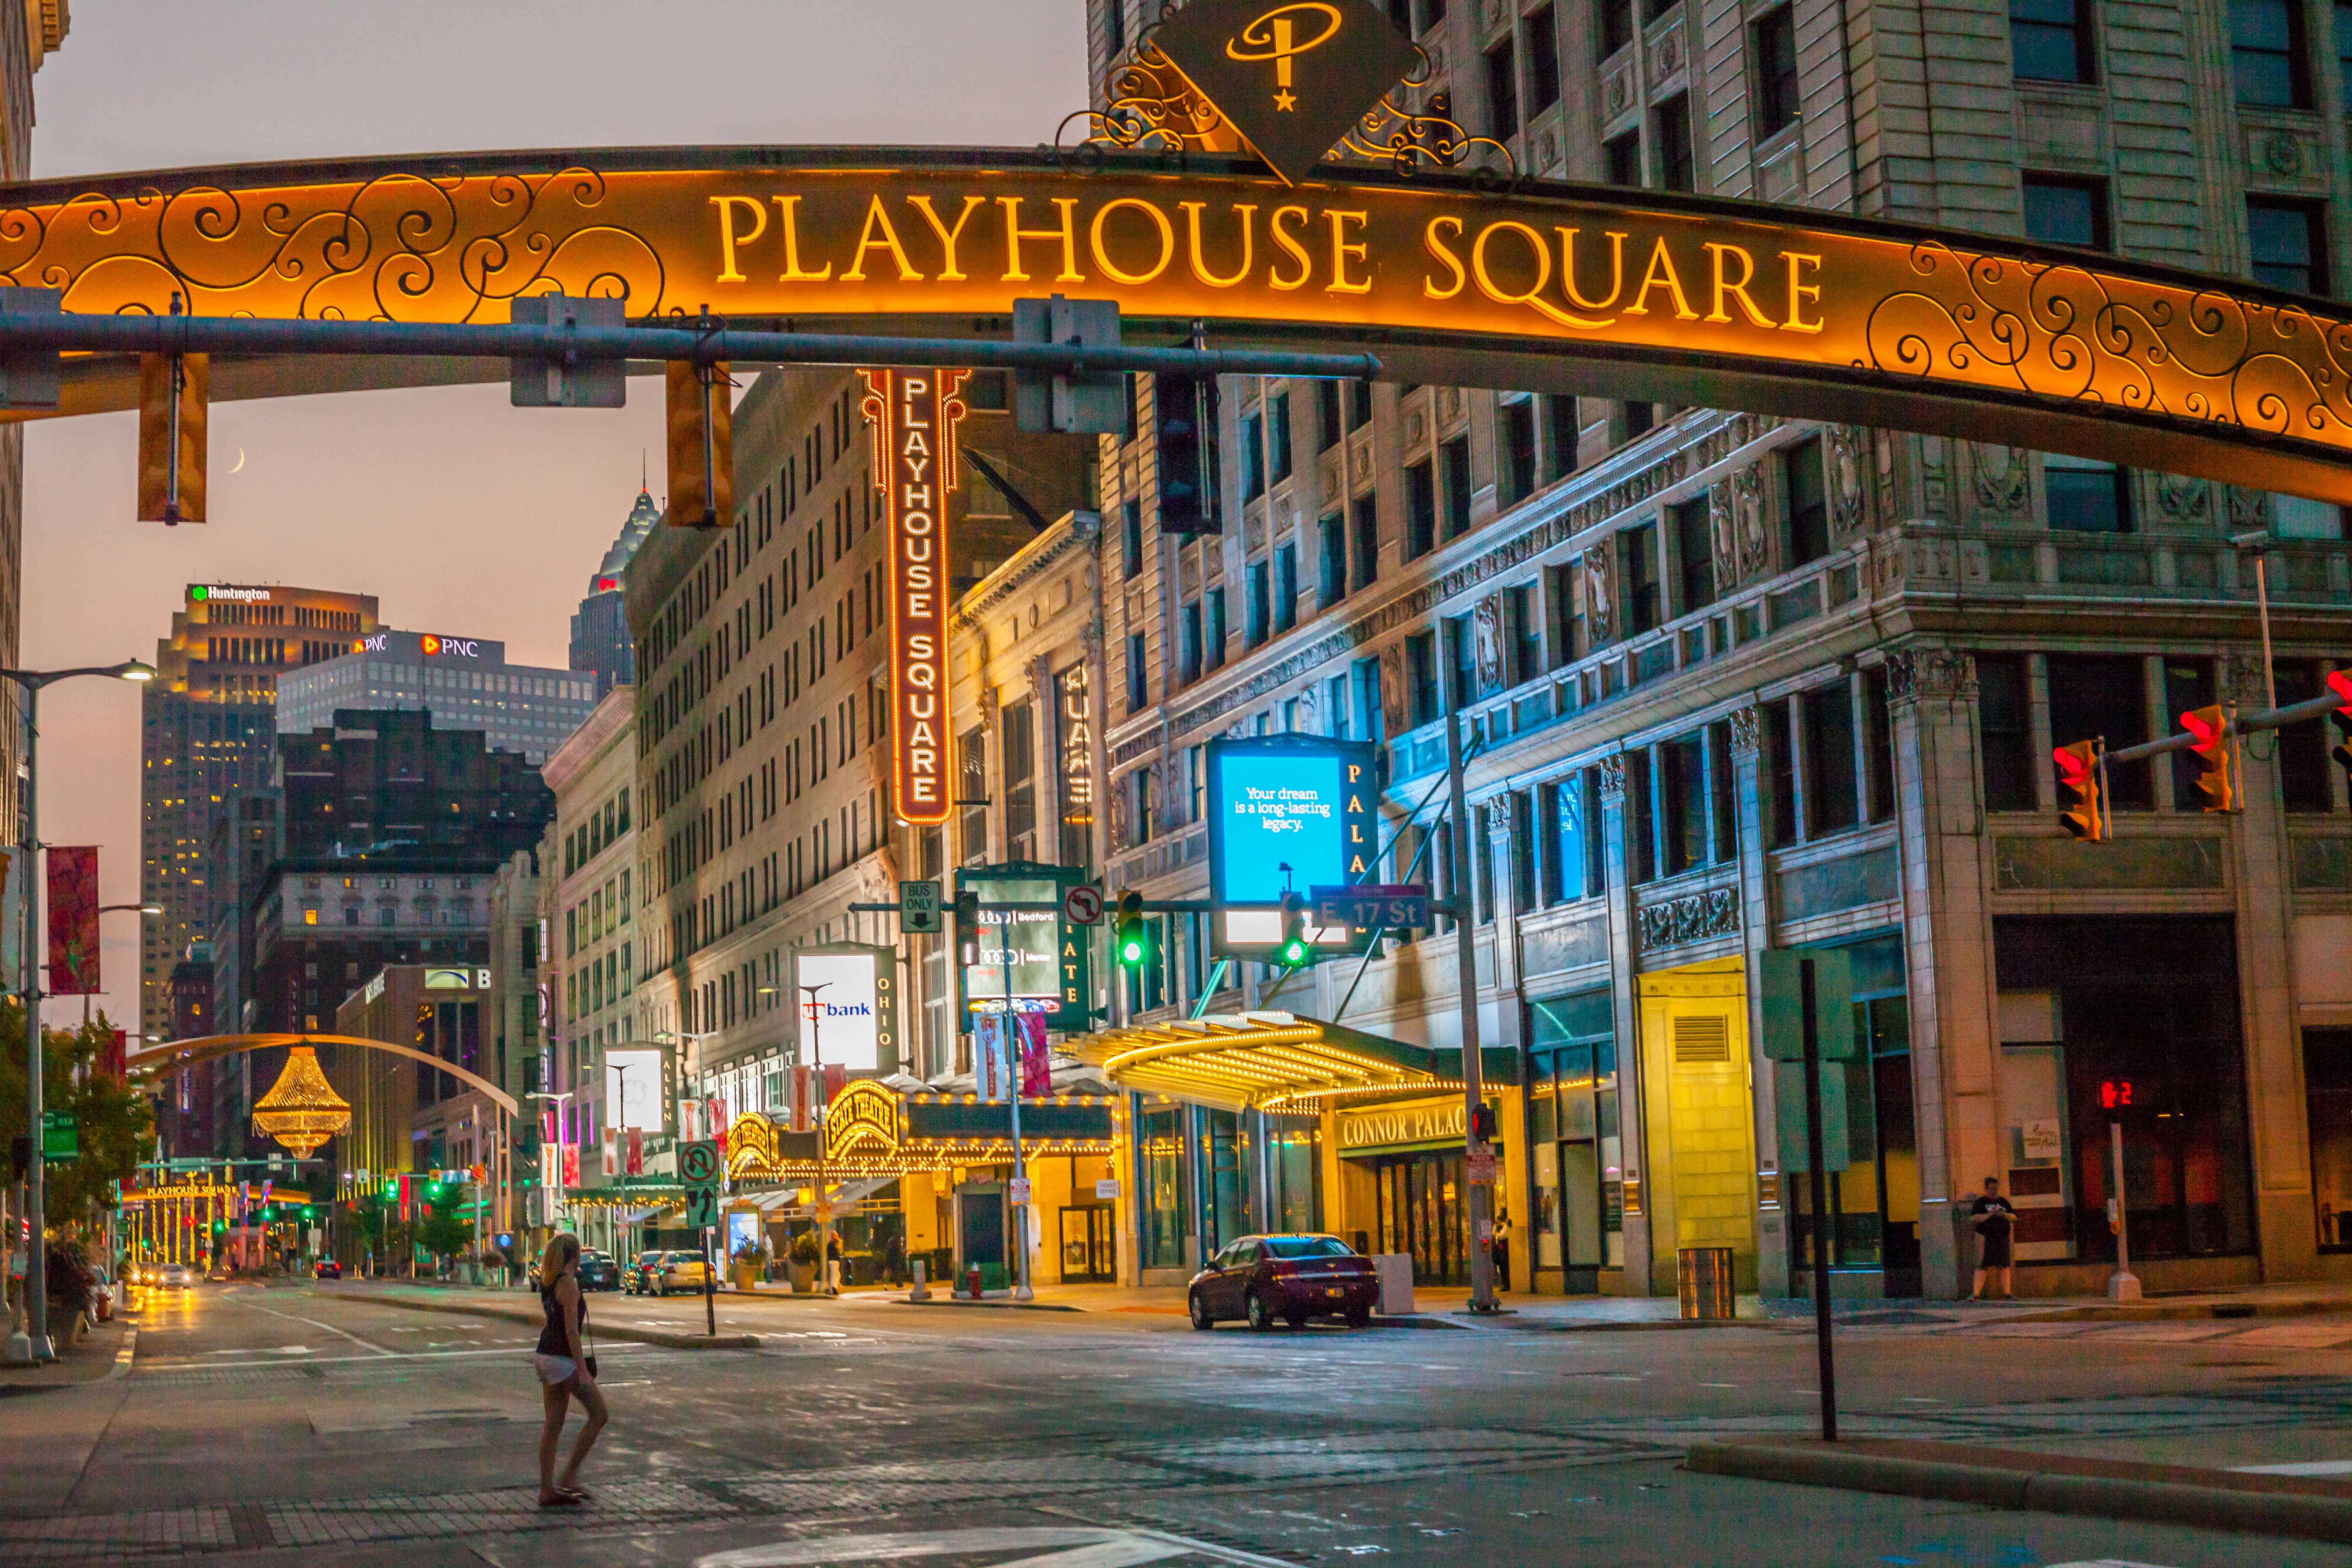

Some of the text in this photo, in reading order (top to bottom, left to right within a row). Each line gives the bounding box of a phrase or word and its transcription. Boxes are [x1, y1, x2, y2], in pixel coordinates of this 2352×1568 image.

[709, 193, 1824, 334] PLAYHOUSE SQUARE
[208, 586, 270, 602] Huntington
[902, 377, 937, 803] PLAYHOUSE SQUARE
[365, 634, 387, 652] PNC
[441, 638, 478, 657] PNC
[1246, 787, 1318, 800] Your dream
[1235, 801, 1330, 818] is a long-lasting
[1263, 816, 1303, 833] legacy.
[909, 885, 929, 896] BUS
[907, 899, 932, 909] ONLY
[1321, 902, 1416, 923] E 17 St
[827, 1003, 871, 1016] bank
[878, 978, 891, 1045] OHIO
[663, 1060, 672, 1121] ALLEN
[830, 1096, 853, 1144] STATE
[854, 1092, 890, 1135] THEATRE
[1344, 1105, 1466, 1146] CONNOR PALAC
